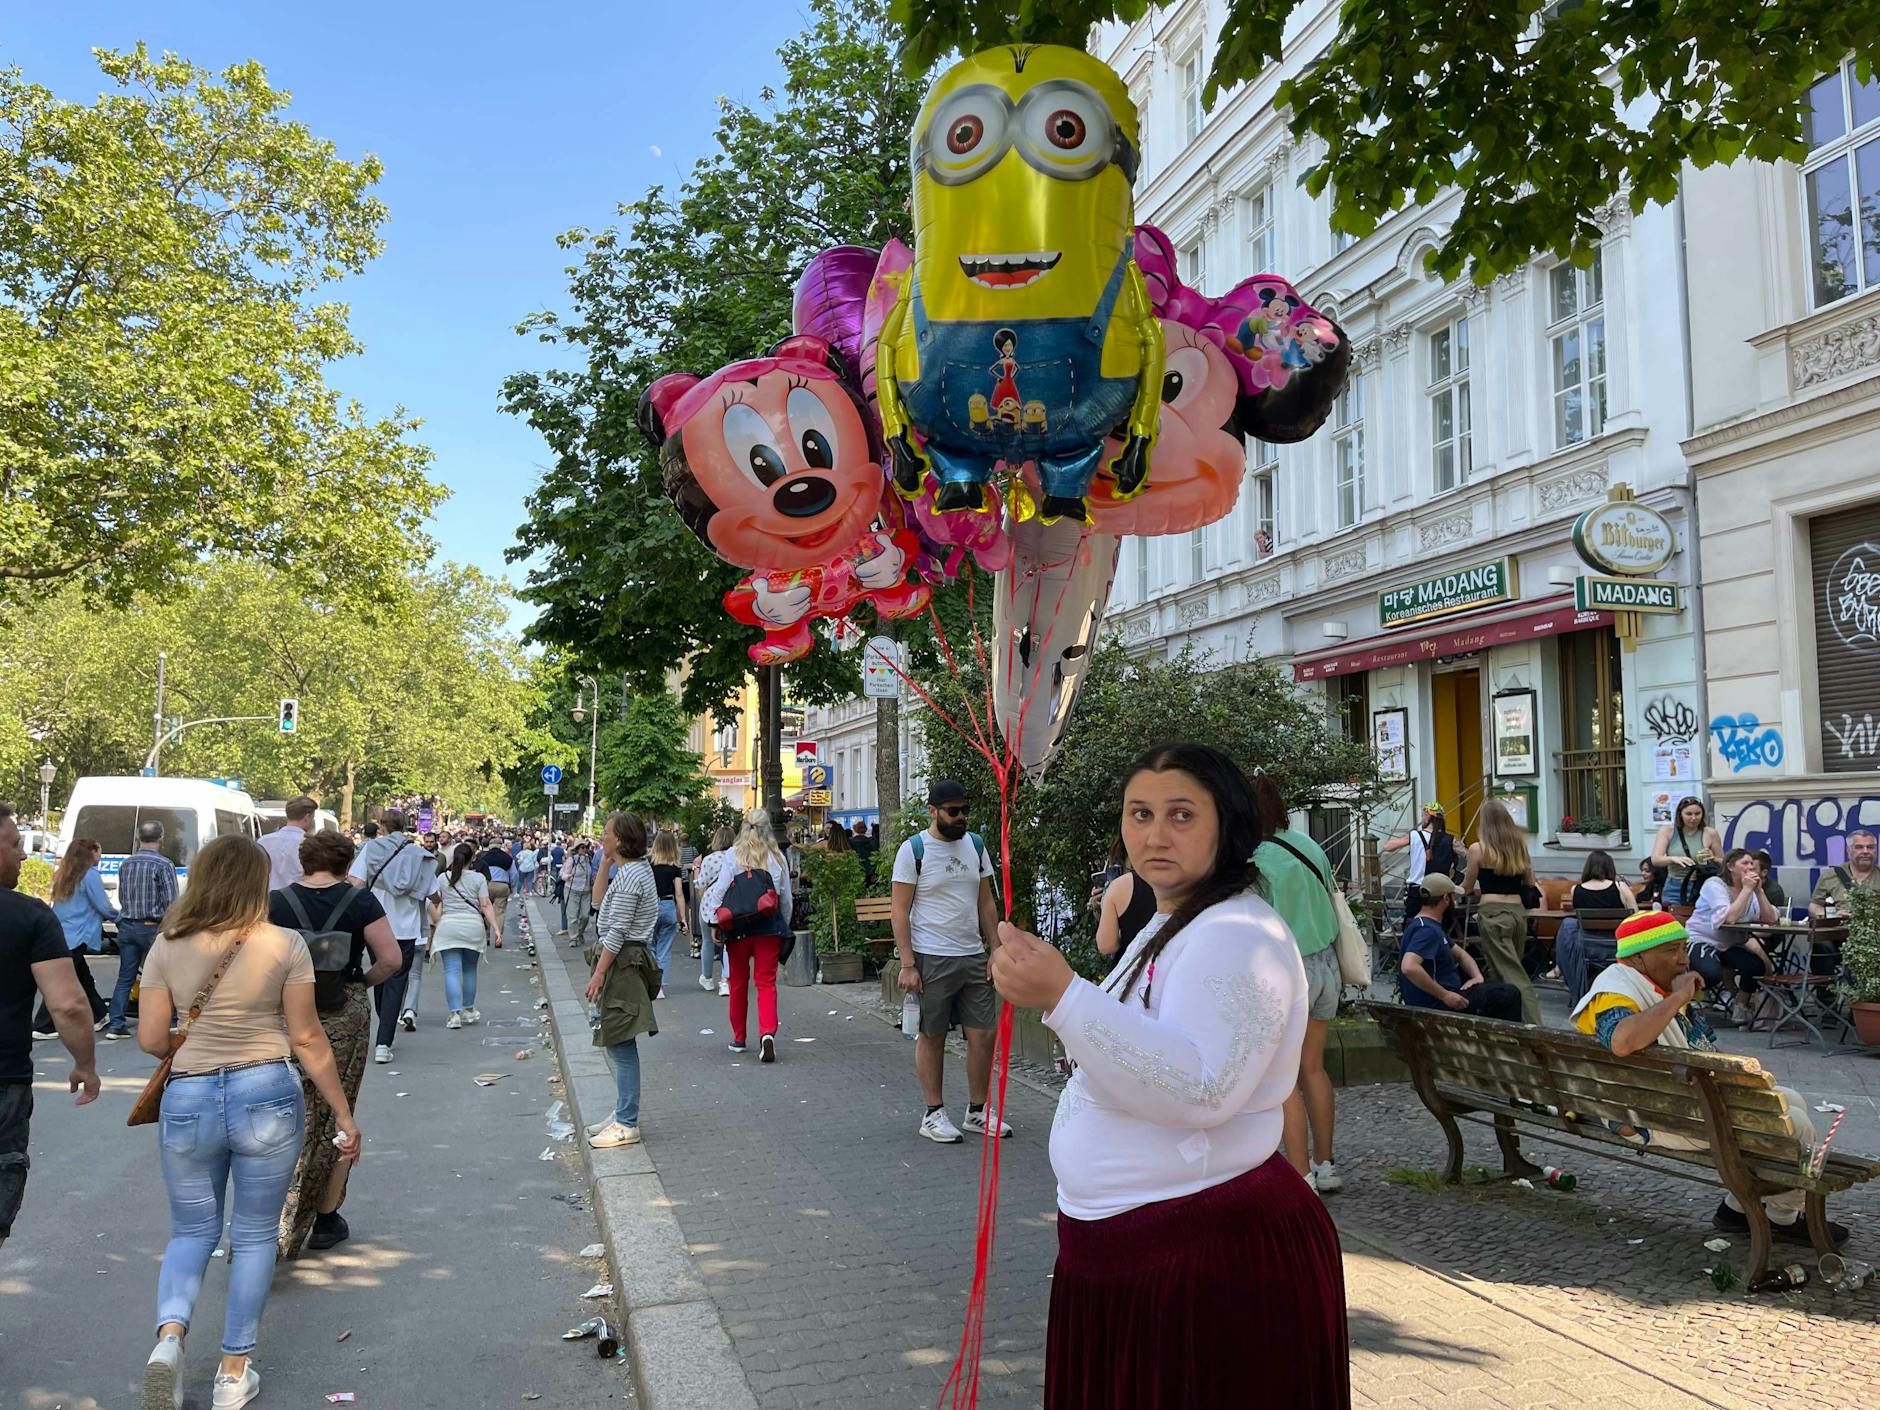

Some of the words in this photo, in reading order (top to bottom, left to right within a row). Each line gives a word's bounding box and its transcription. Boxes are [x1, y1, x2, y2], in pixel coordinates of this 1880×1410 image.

[1601, 521, 1665, 552] Bitburger
[1418, 565, 1498, 604] MADANG
[1596, 583, 1673, 606] MADANG
[1385, 600, 1443, 622] Koreanisches
[1443, 586, 1499, 608] Restaurant
[1453, 634, 1486, 649] Madang
[1372, 651, 1408, 664] Restaurant
